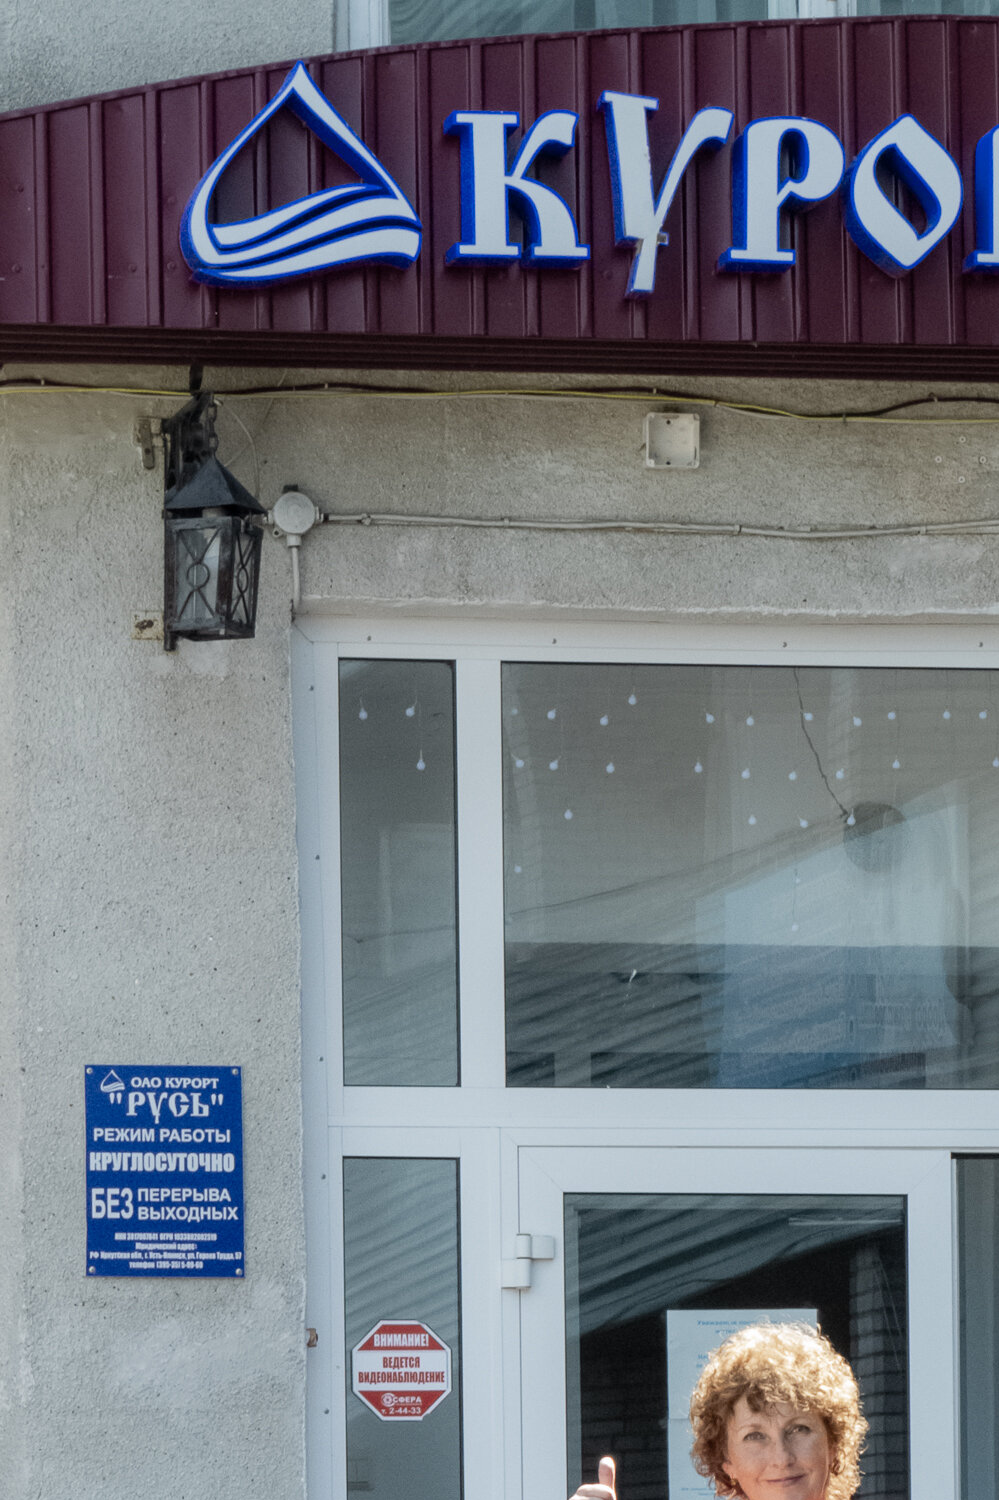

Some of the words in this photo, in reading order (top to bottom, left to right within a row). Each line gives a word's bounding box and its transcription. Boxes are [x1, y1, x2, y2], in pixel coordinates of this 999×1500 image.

[131, 1077, 161, 1088] ОАО
[165, 1077, 219, 1090] КУРОРТ
[93, 1128, 155, 1142] РЕЖИМ
[159, 1129, 231, 1143] РАБОТЫ
[89, 1151, 235, 1172] КРУГЛОСУТОЧНО
[137, 1188, 232, 1202] ПЕРЕРЫВА
[91, 1188, 134, 1219] БЕЗ
[137, 1206, 239, 1223] ВЫХОДНЫХ
[373, 1333, 429, 1347] ВНИМАНИЕ!
[382, 1356, 420, 1370] ВЕДЕТСЯ
[358, 1371, 445, 1385] ВИДЕОНАБЛЮДЕНИЕ
[389, 1407, 421, 1415] 2-44-33
